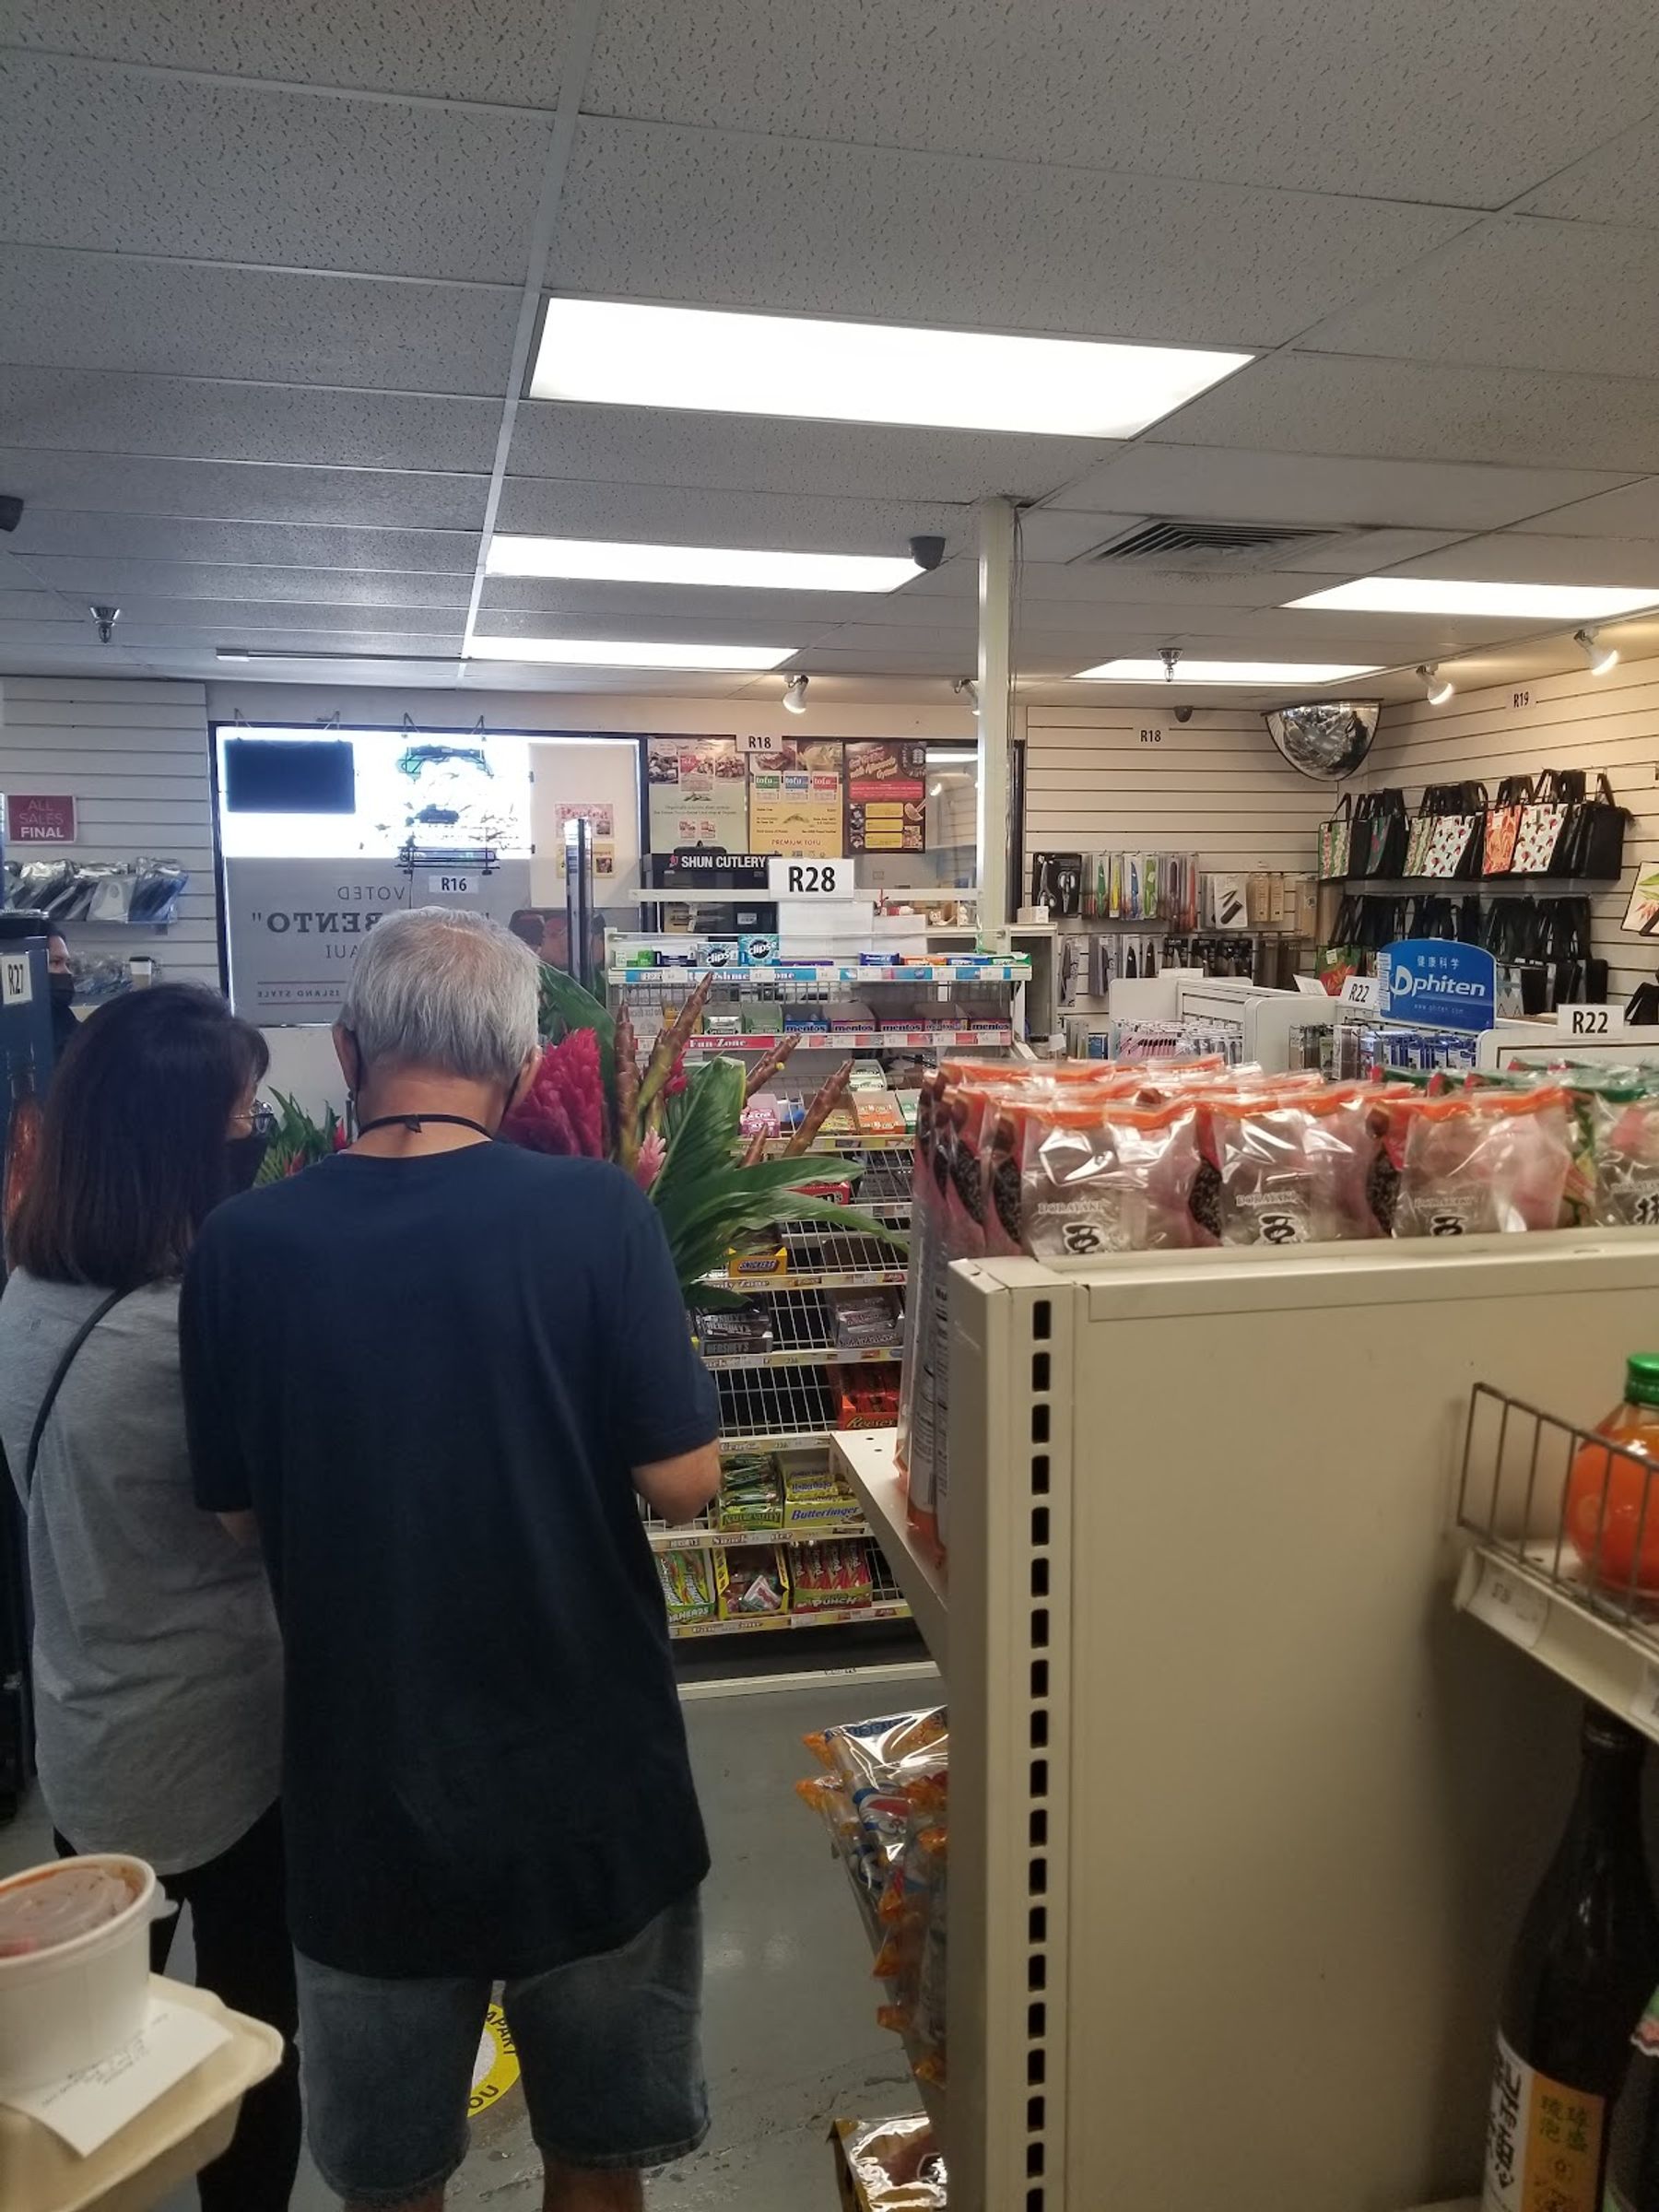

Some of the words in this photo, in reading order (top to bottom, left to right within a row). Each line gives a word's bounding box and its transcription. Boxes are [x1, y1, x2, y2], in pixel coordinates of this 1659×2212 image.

[1513, 692, 1530, 708] R19
[747, 735, 771, 749] R18
[1140, 729, 1161, 743] R18
[29, 799, 53, 811] ALL
[18, 812, 64, 825] SALES
[20, 826, 65, 838] FINAL
[681, 855, 713, 868] SHUN
[716, 855, 766, 868] CUTLERY
[441, 877, 467, 891] R16
[788, 865, 836, 893] R28
[7, 963, 24, 996] R27
[1411, 973, 1486, 997] phiten
[1347, 982, 1371, 1004] R22
[834, 1024, 874, 1032] mentos
[882, 1024, 922, 1032] mentos
[971, 1021, 1011, 1030] mentos
[1571, 1010, 1609, 1034] R22
[785, 1025, 827, 1033] mentos
[689, 1038, 712, 1049] Fun
[716, 1037, 747, 1048] Zone
[739, 1260, 776, 1270] SNICKERS
[791, 1505, 860, 1521] Butterfinger
[812, 1596, 858, 1607] PUNCH
